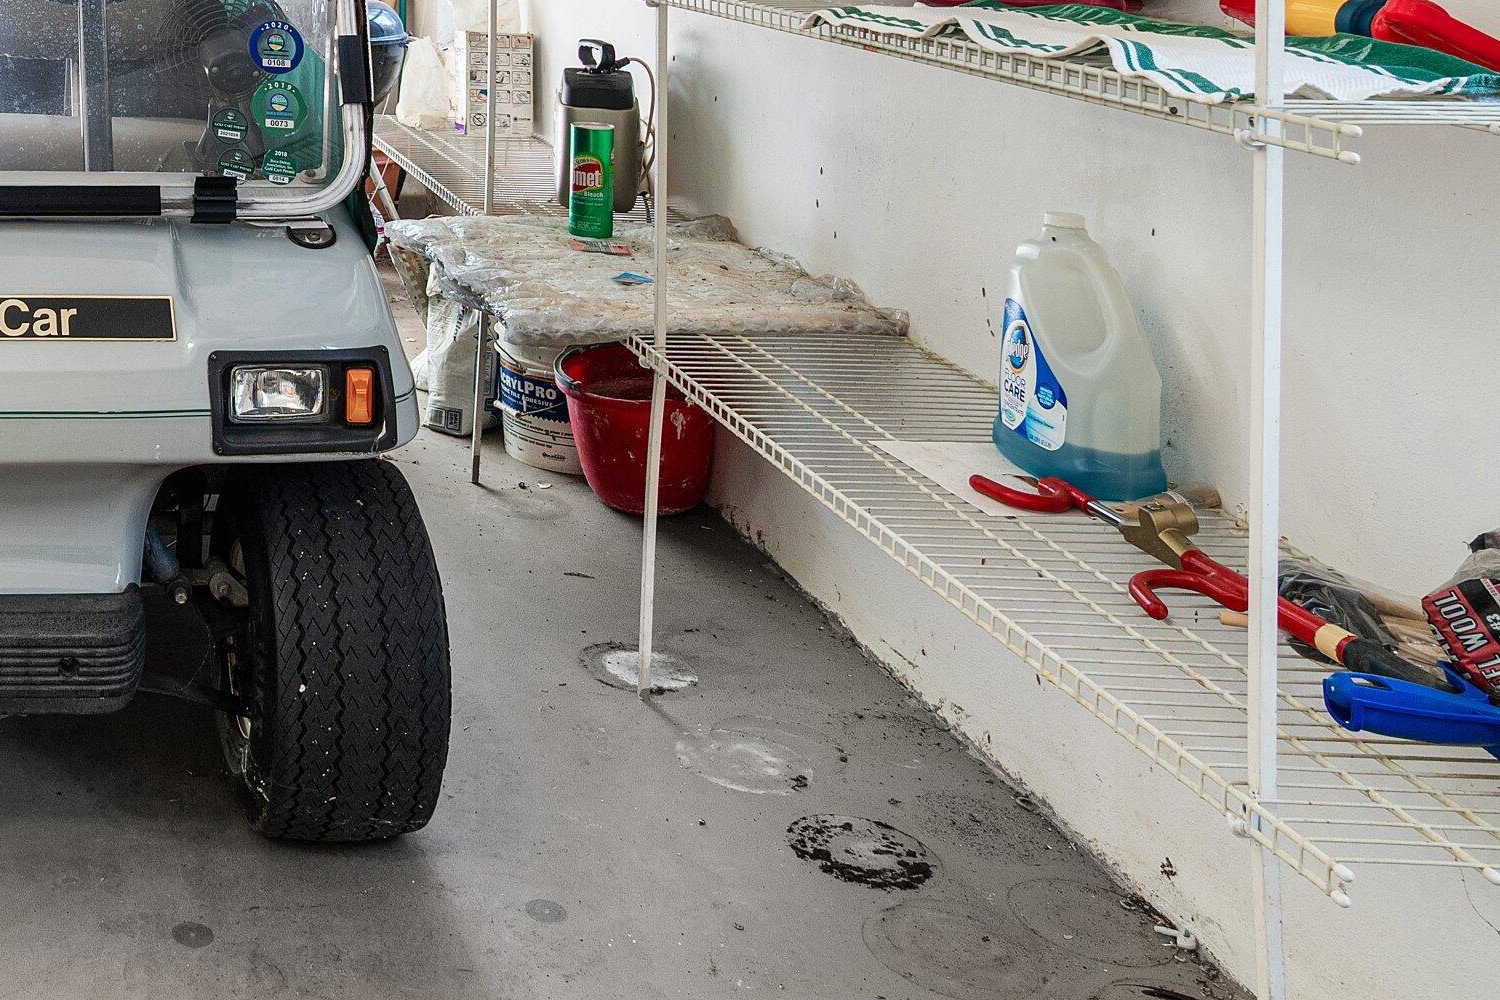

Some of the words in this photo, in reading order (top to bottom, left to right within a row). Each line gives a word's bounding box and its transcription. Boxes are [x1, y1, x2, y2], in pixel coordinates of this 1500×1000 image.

[265, 22, 289, 30] 2020
[267, 59, 286, 67] 0108
[268, 82, 292, 91] 2019
[270, 119, 289, 128] 0073
[274, 150, 288, 158] 2018
[1004, 367, 1026, 389] FLOOR
[1003, 379, 1026, 403] CARE
[1434, 591, 1490, 652] WOOL
